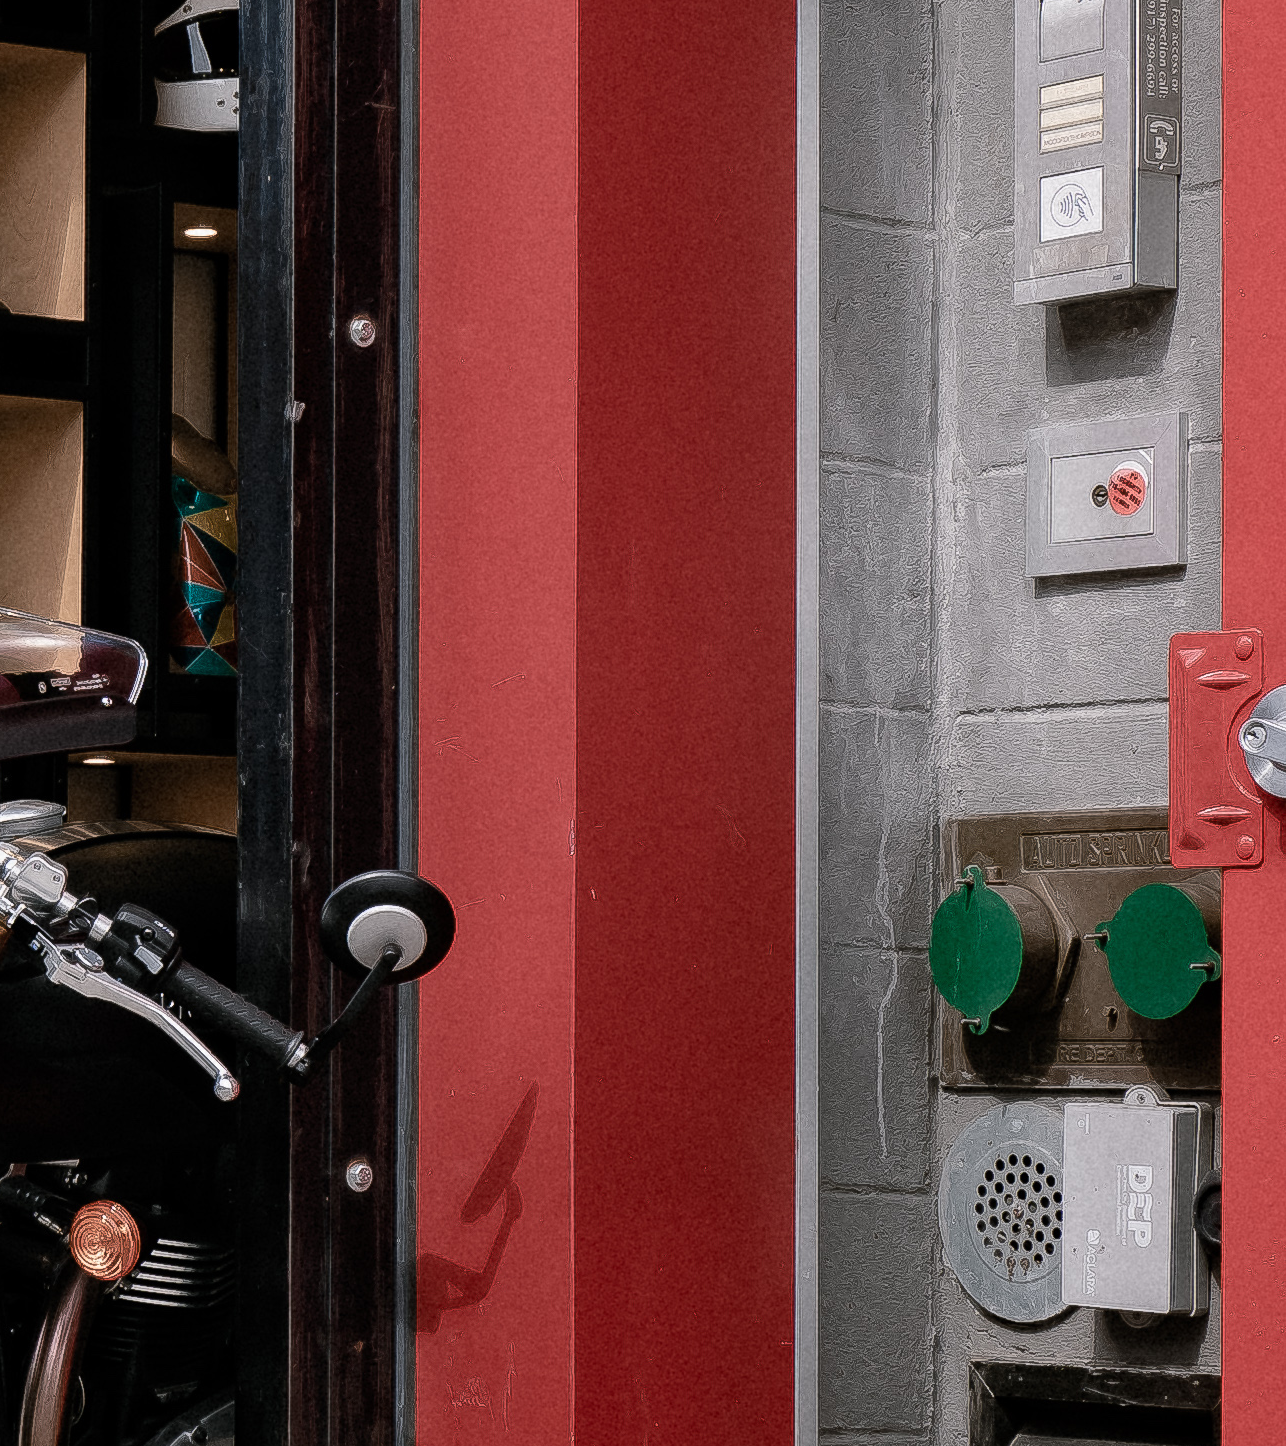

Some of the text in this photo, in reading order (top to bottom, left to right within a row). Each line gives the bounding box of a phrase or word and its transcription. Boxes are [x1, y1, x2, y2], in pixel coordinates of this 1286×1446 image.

[1157, 0, 1169, 67] inspection
[1171, 7, 1181, 94] For access or
[1026, 836, 1082, 868] AUTO
[1127, 1164, 1154, 1249] DEP
